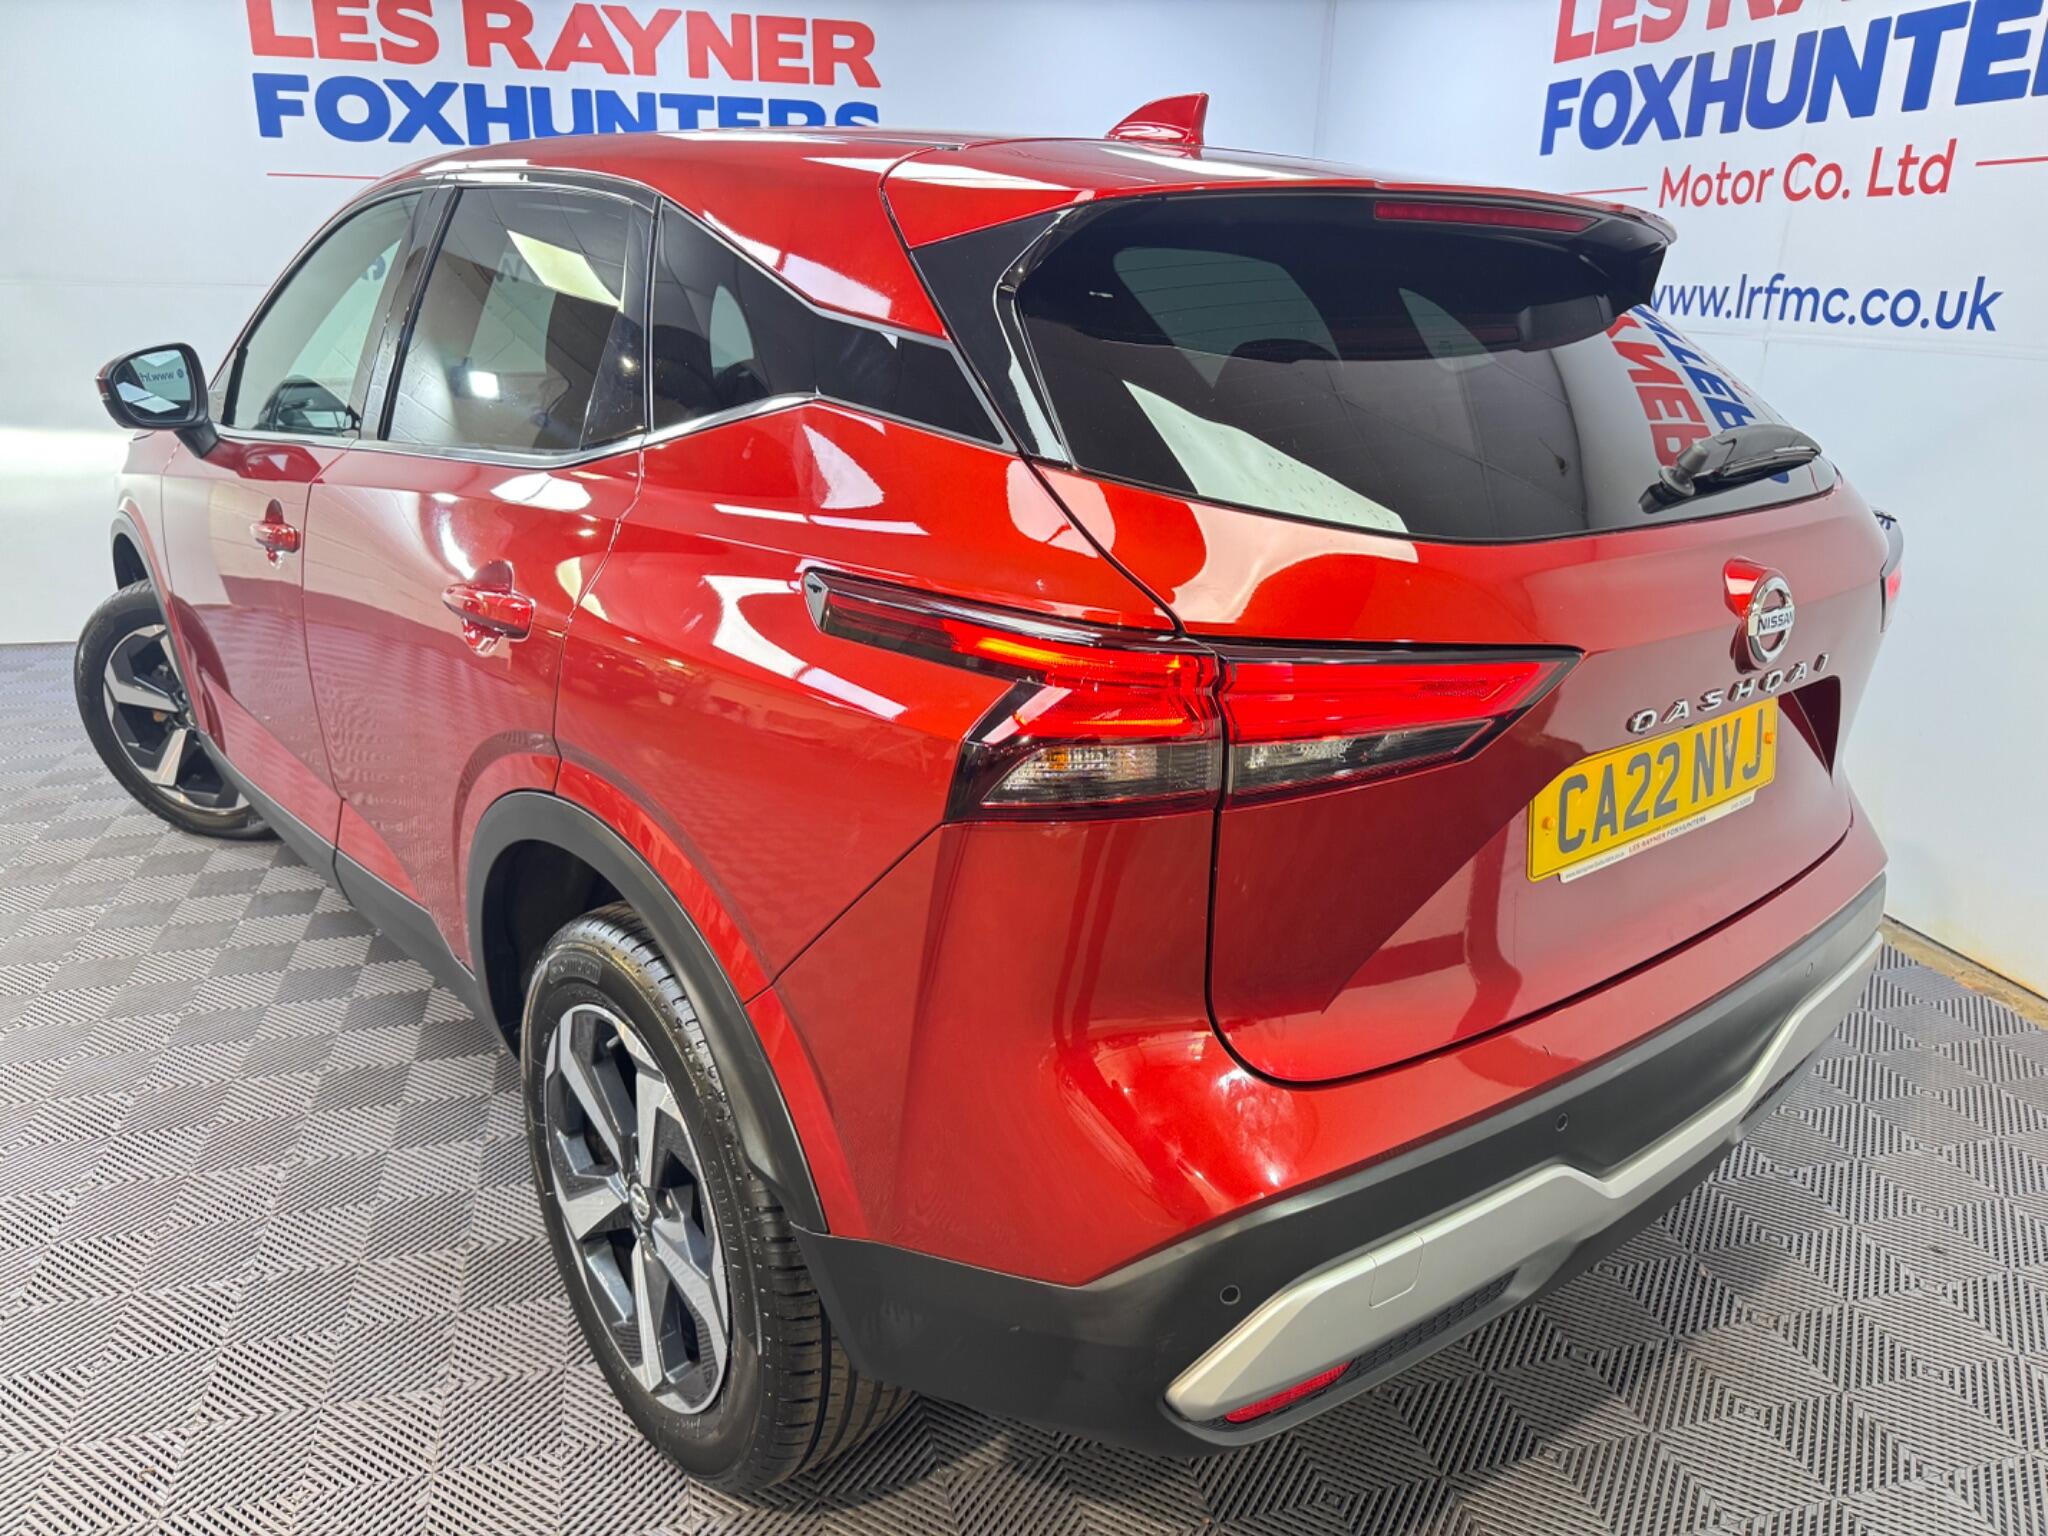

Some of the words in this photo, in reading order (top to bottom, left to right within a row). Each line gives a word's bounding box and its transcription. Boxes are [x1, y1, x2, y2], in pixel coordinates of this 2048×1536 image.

[247, 0, 441, 65] LES
[463, 0, 881, 88] RAYNER
[1539, 0, 2048, 156] FOXHUNTE
[1658, 161, 1774, 209] Motor
[1782, 152, 1850, 202] Co.
[1866, 138, 1957, 198] Ltd
[1758, 611, 1793, 631] NISSAN
[1627, 654, 1829, 735] QASHQAI
[1559, 742, 1681, 854] CA22
[1691, 709, 1764, 804] NVJ
